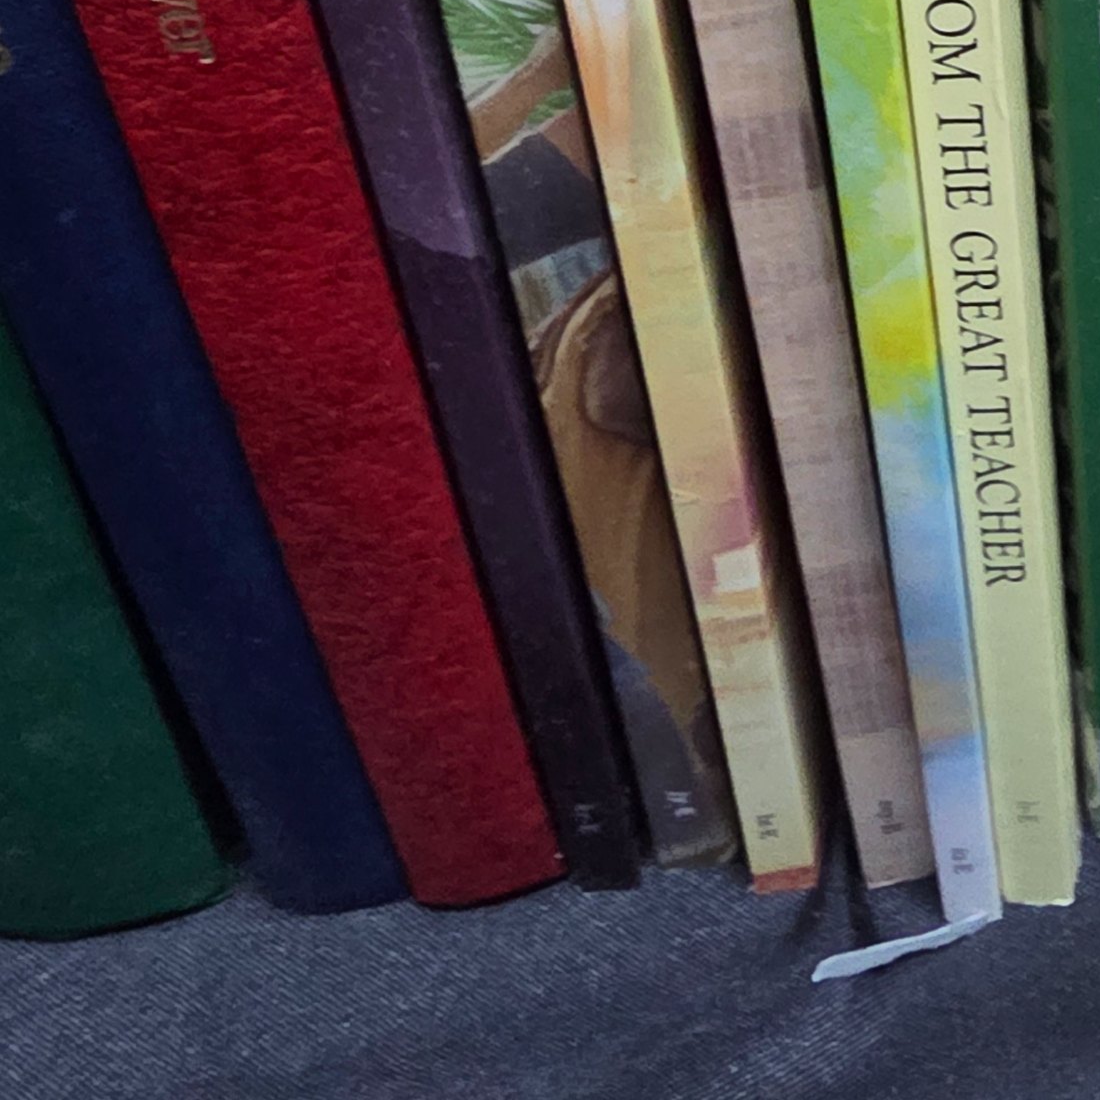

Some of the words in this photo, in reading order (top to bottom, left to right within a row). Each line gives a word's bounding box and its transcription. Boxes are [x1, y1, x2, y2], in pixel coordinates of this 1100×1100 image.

[935, 103, 994, 210] THE
[948, 230, 1008, 383] GREAT
[966, 396, 1027, 588] TEACHER
